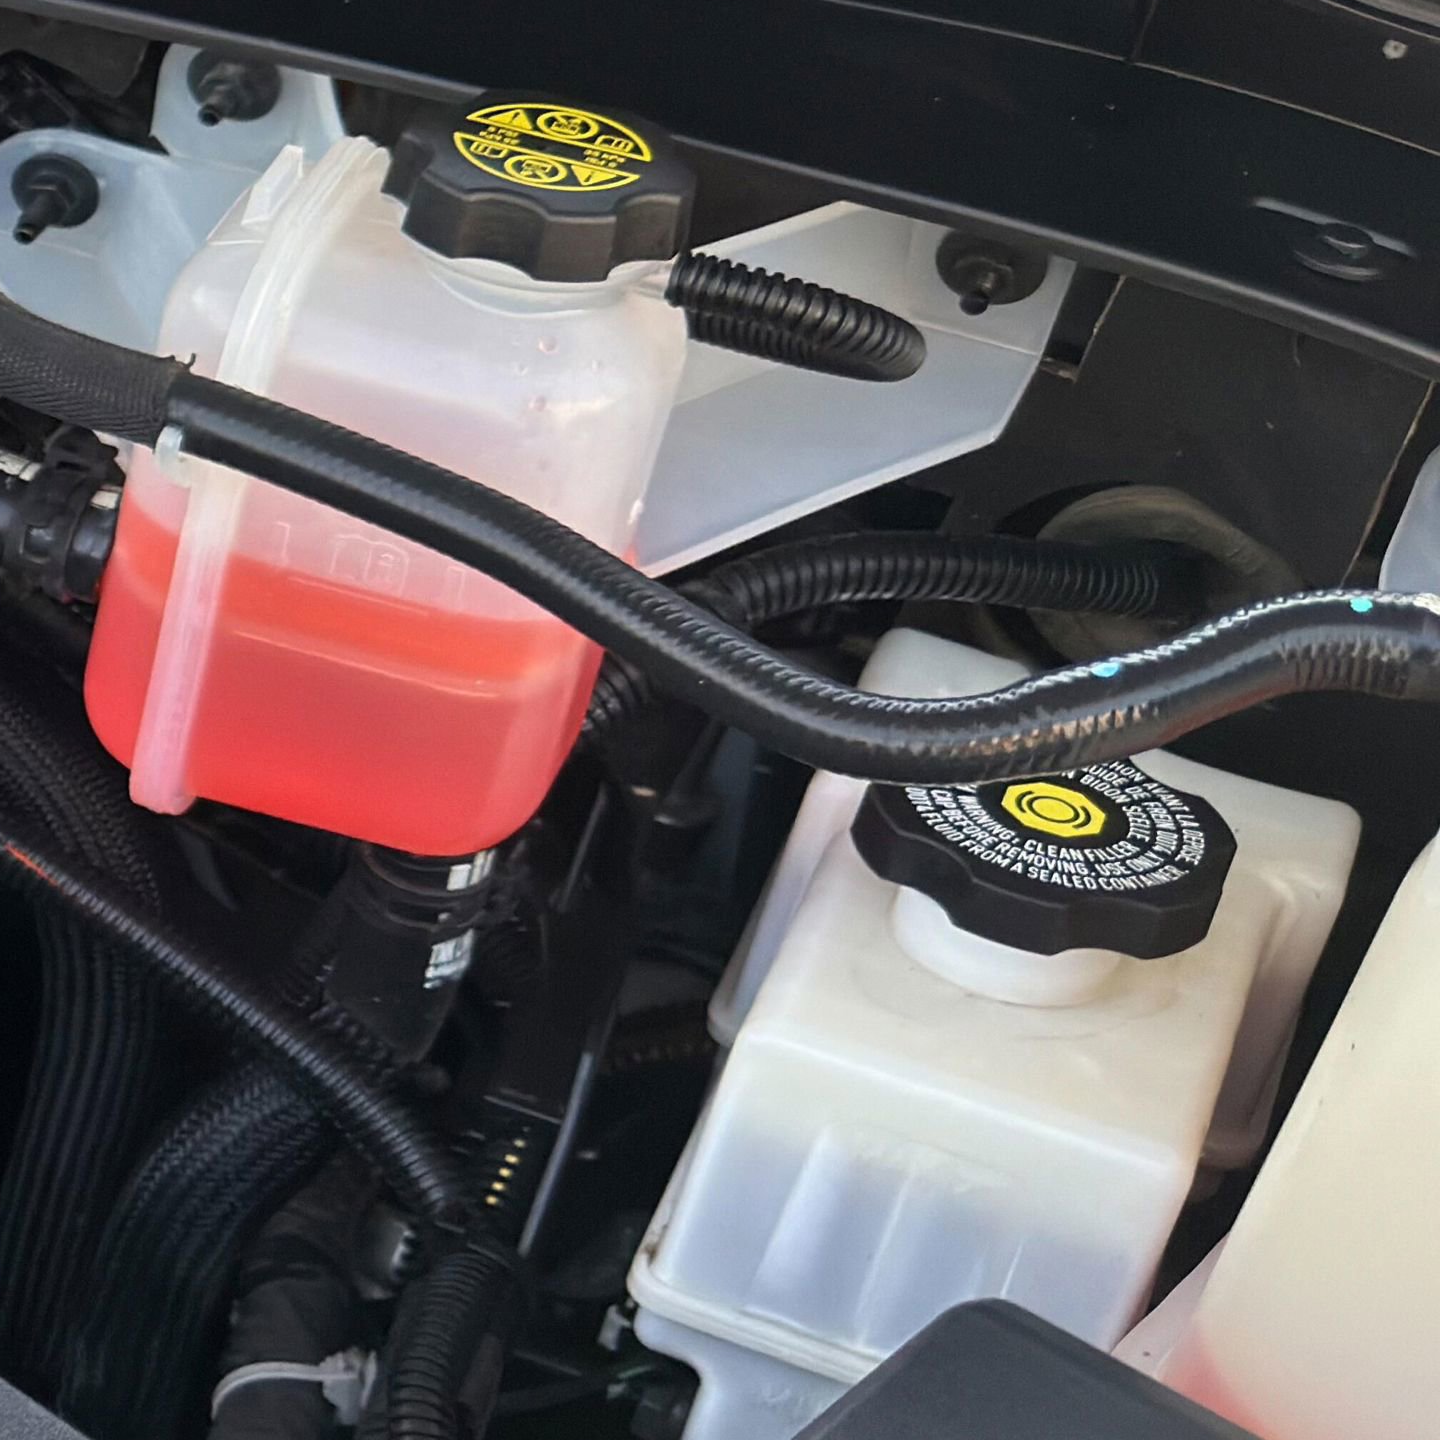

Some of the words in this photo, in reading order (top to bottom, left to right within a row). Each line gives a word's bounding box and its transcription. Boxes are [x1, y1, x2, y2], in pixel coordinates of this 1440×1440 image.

[930, 788, 957, 809] CAP
[1080, 773, 1130, 804] BIDON
[1122, 804, 1153, 843] SCELLE
[1082, 764, 1130, 788] UIDE
[1124, 786, 1152, 801] DE
[1142, 800, 1177, 832] FREIN
[1102, 760, 1145, 782] HON
[1143, 782, 1191, 813] AVANT
[1175, 813, 1200, 827] LA
[920, 811, 966, 842] FLUID
[959, 838, 1012, 869] FROM
[1010, 862, 1024, 875] A
[1027, 865, 1097, 891] SEALED
[1098, 863, 1191, 892] CONTAINER.
[942, 809, 999, 847] BEFORE
[957, 794, 1021, 845] WARNING:
[1024, 838, 1083, 862] CLEAN
[1084, 839, 1142, 863] FILLER
[995, 843, 1097, 877] REMOVING.
[1095, 859, 1131, 878] USE
[1125, 849, 1165, 875] ONLY
